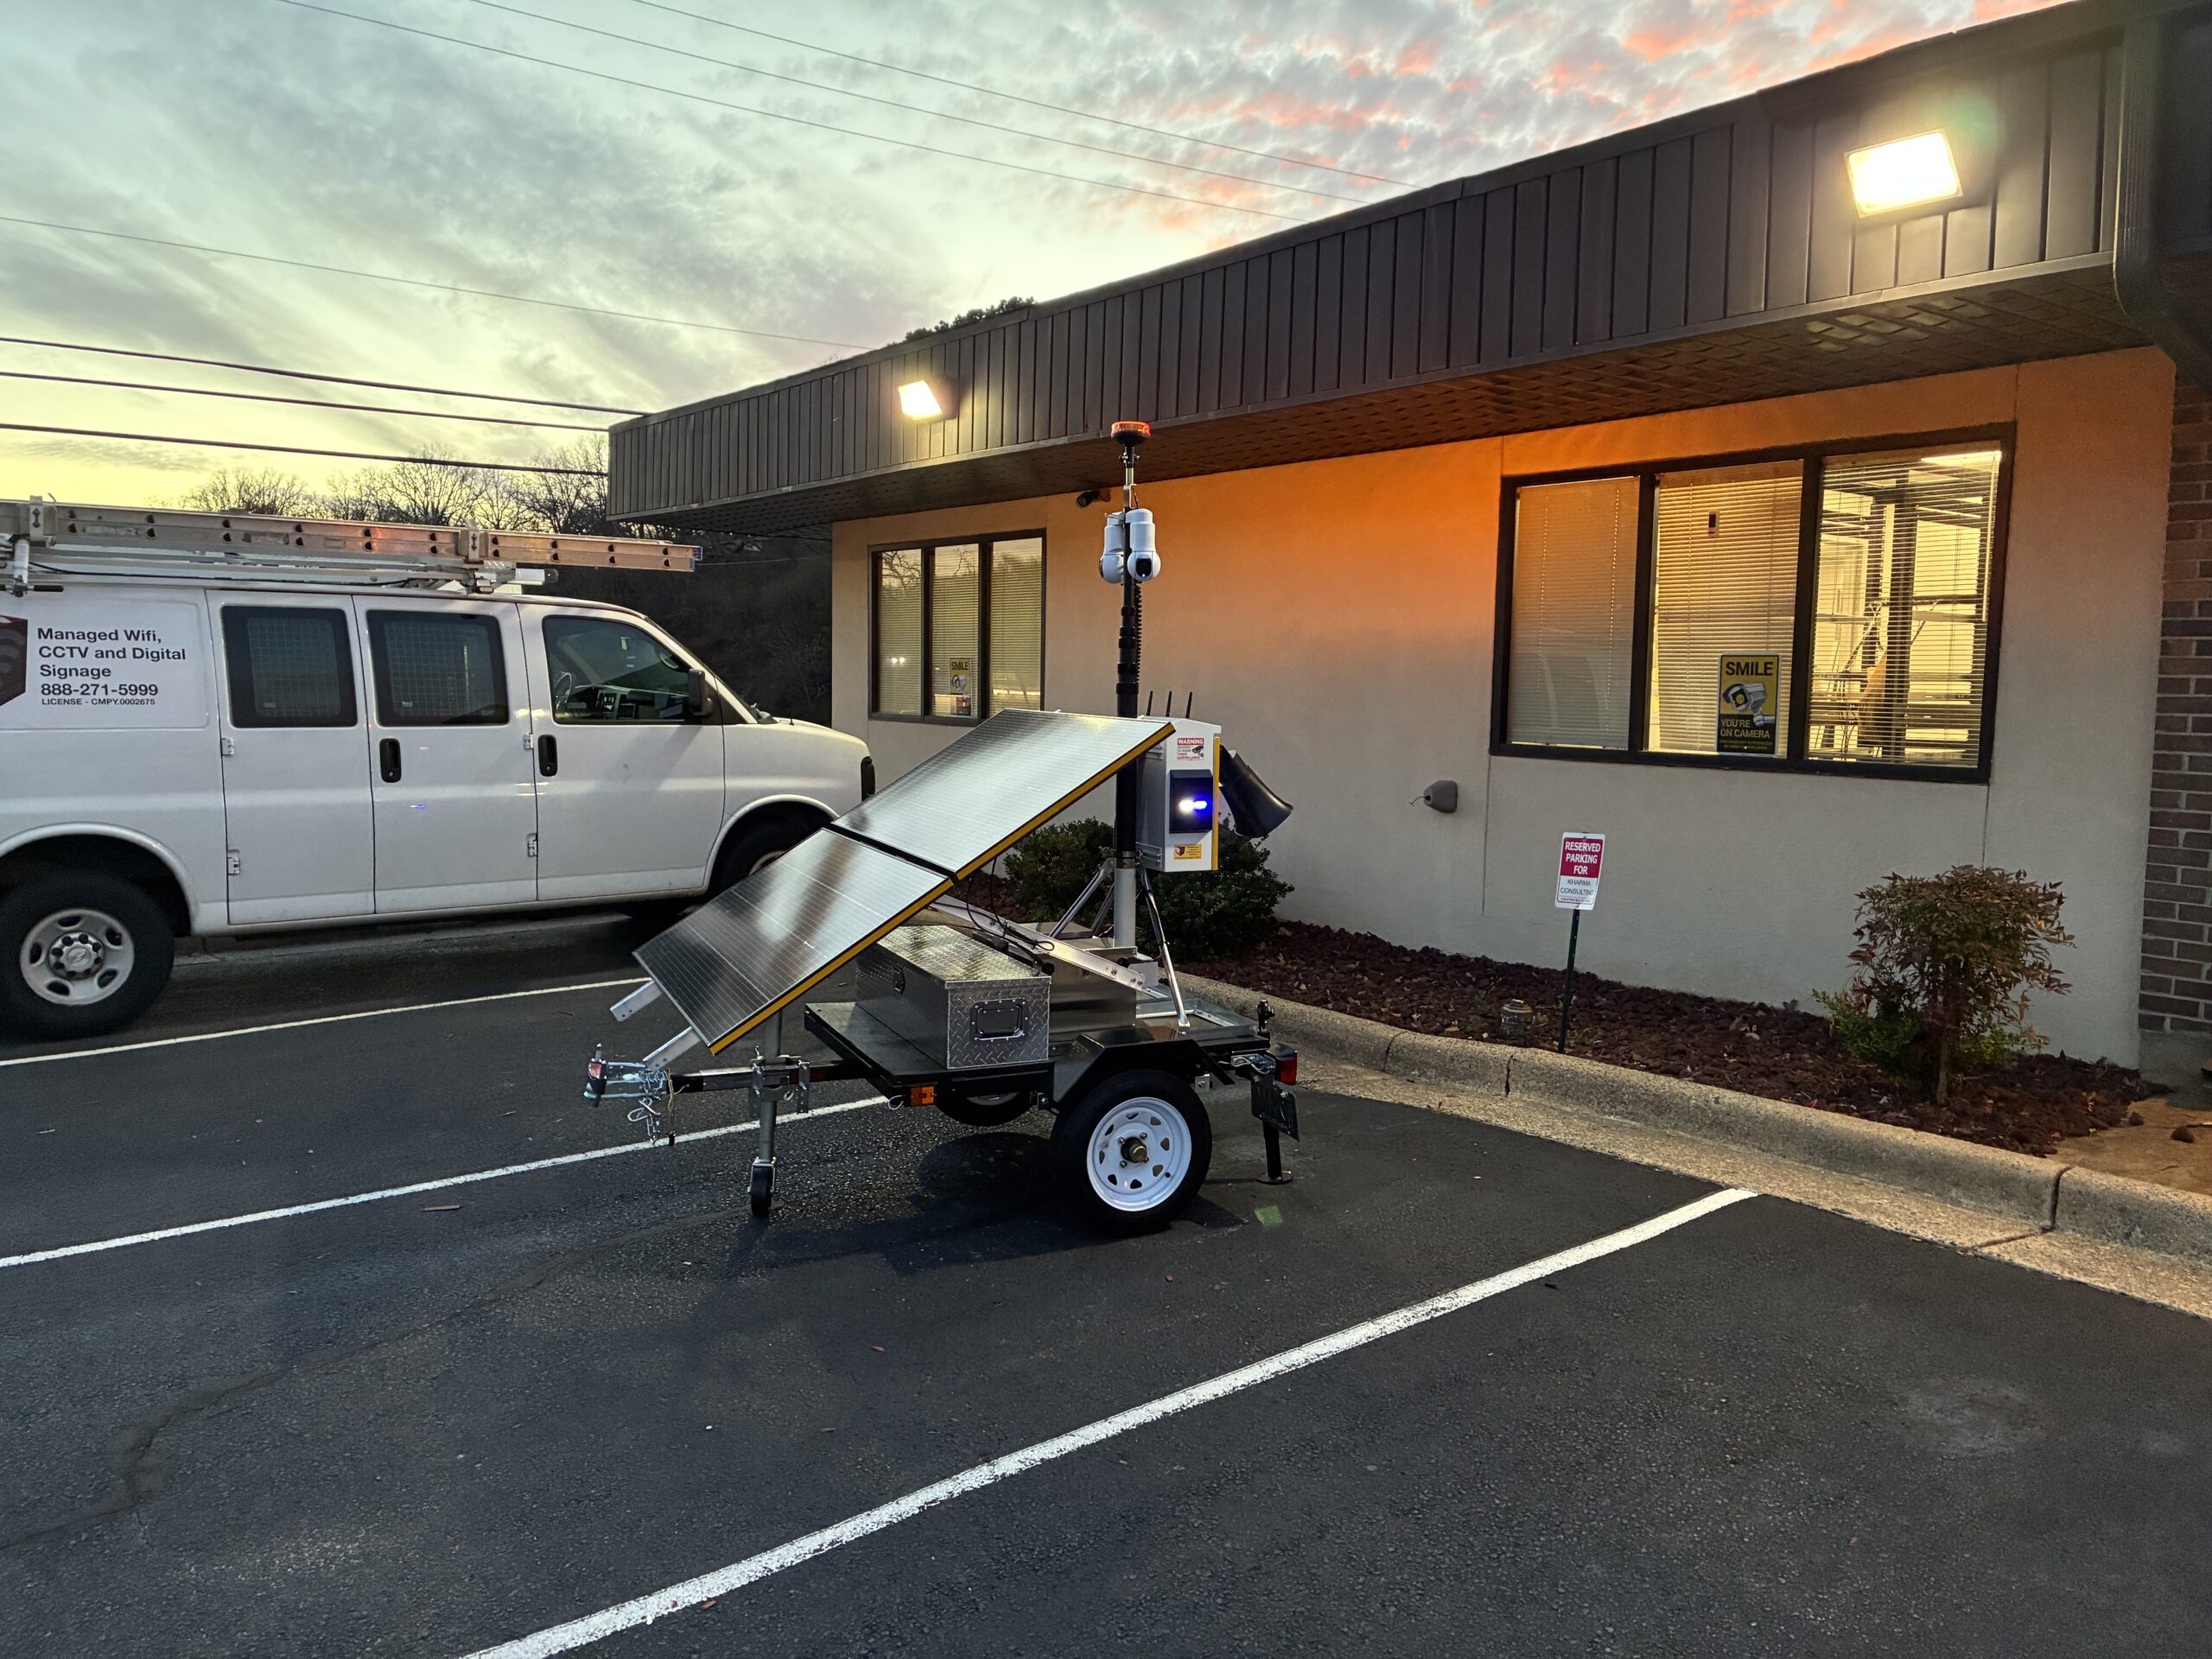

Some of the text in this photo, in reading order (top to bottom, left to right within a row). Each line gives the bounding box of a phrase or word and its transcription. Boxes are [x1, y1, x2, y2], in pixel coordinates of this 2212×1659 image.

[37, 627, 162, 644] Managed Wifi,
[38, 645, 186, 662] CCTV and Digital
[40, 664, 111, 679] Signage
[951, 661, 969, 671] SMILE
[1726, 661, 1773, 676] SMILE
[41, 683, 158, 696] 888-271-5999
[1720, 719, 1751, 728] YOU'RE
[1720, 728, 1770, 739] ON CAMERA
[1565, 842, 1600, 852] RESERVED
[1566, 853, 1598, 863] PARKING
[1573, 865, 1587, 874] FOR
